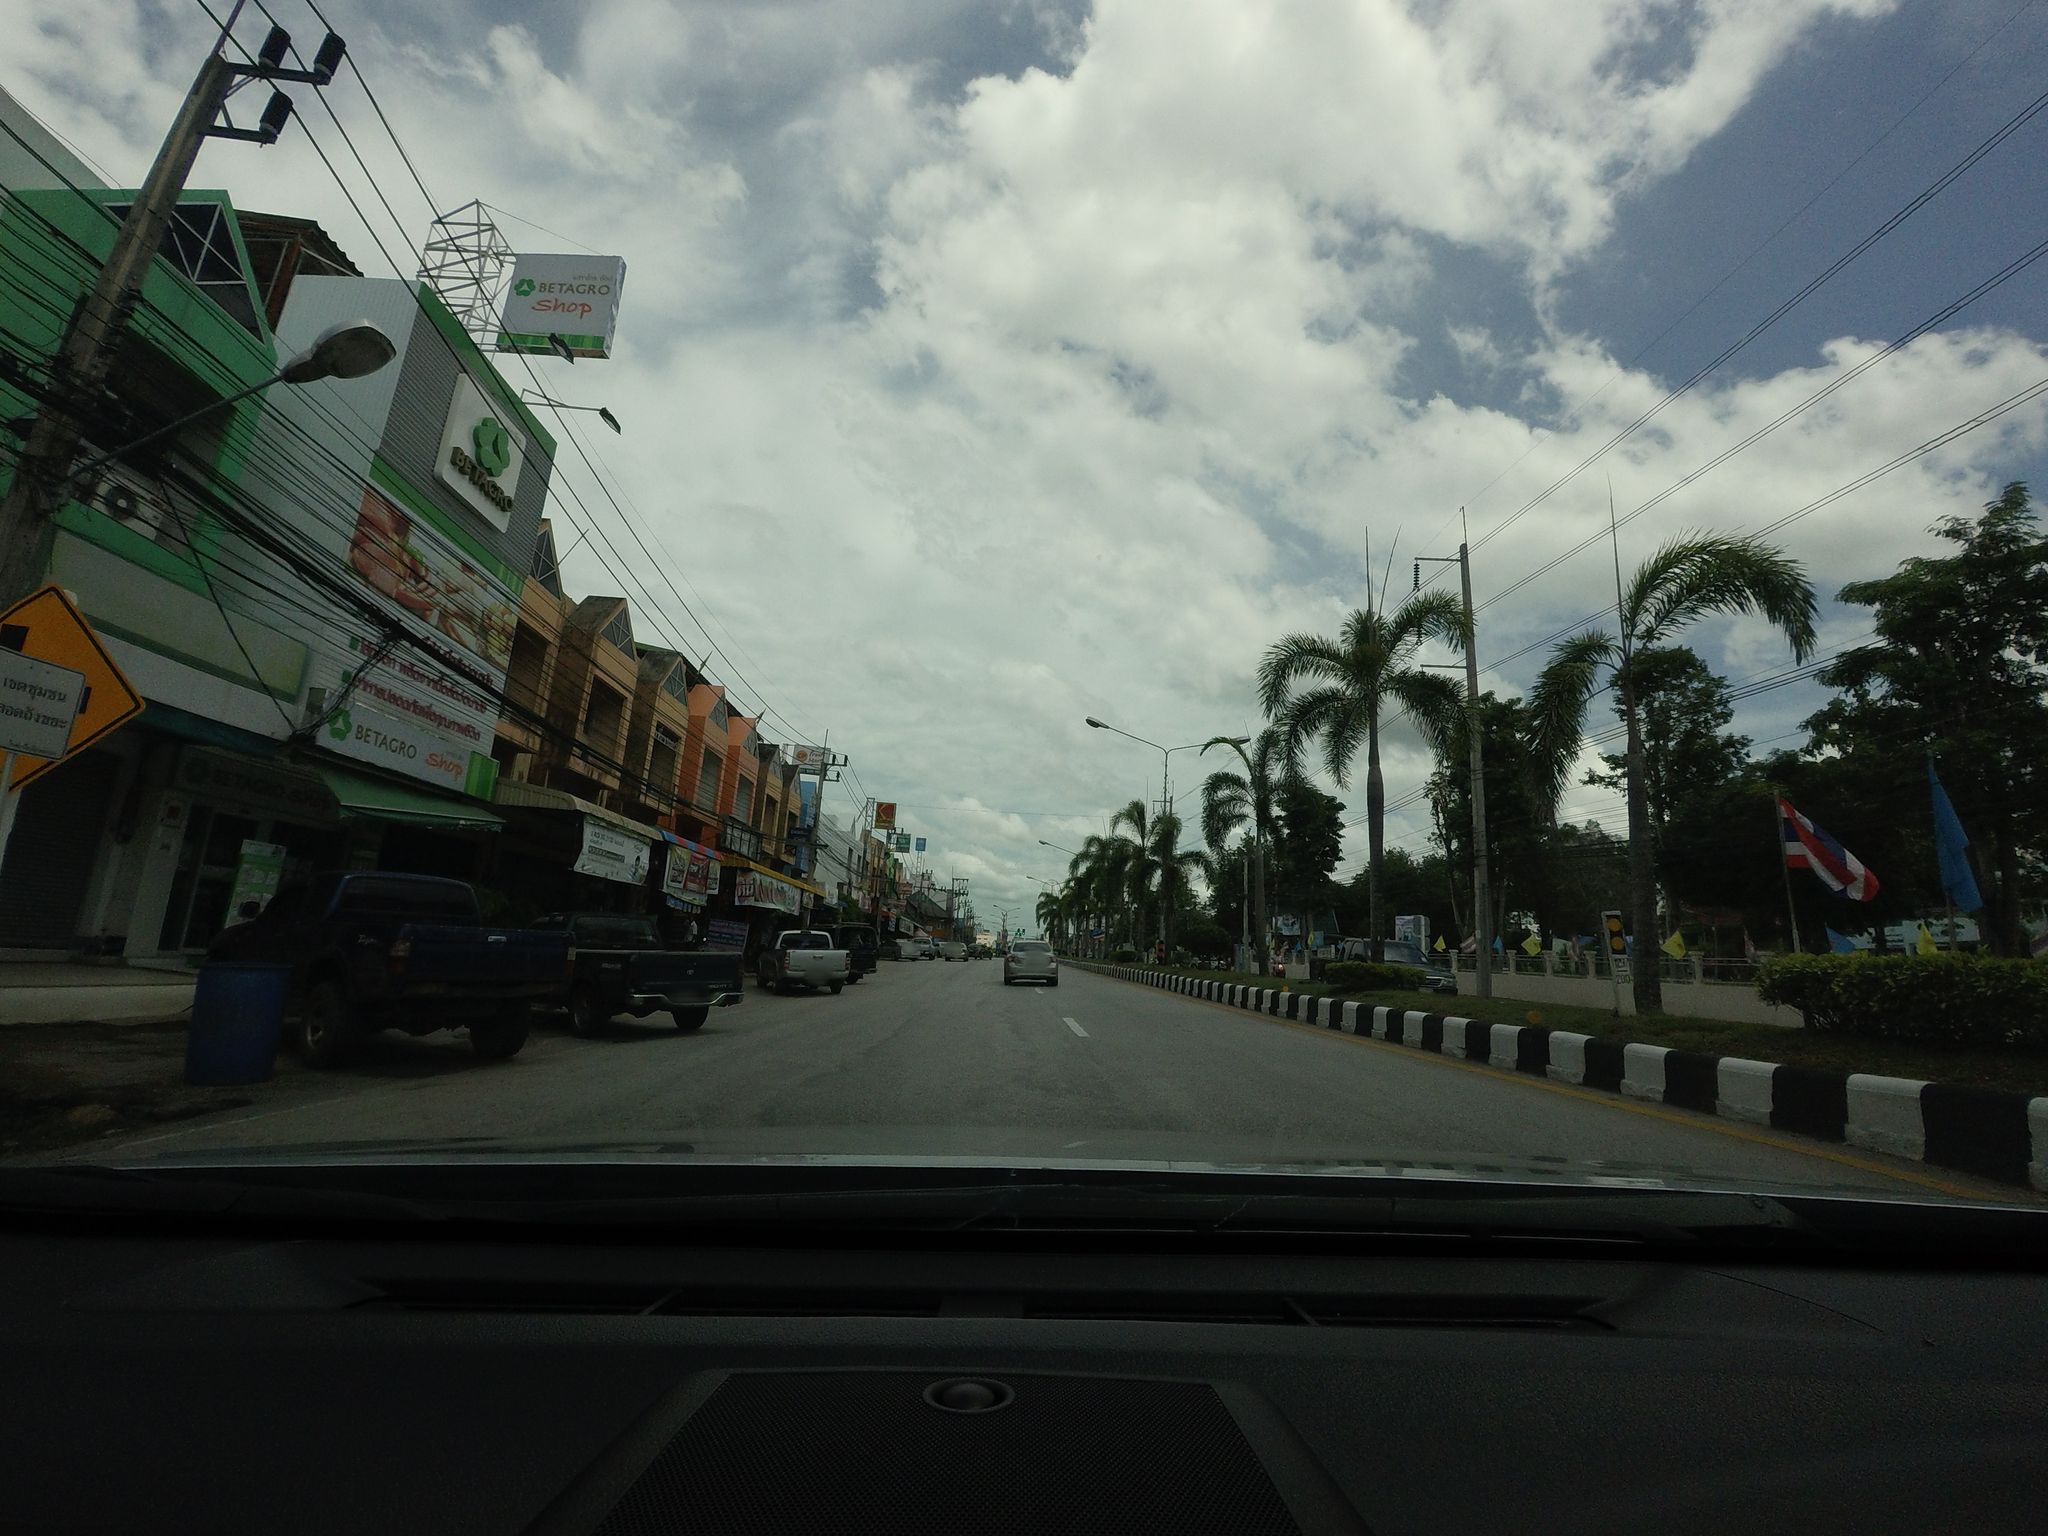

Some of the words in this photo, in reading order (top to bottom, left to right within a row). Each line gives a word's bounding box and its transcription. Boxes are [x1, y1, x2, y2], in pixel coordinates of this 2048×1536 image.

[539, 282, 610, 296] BETAGRO
[531, 298, 592, 319] Shop
[450, 446, 513, 512] BETAGRO
[354, 724, 417, 760] BETAGRO
